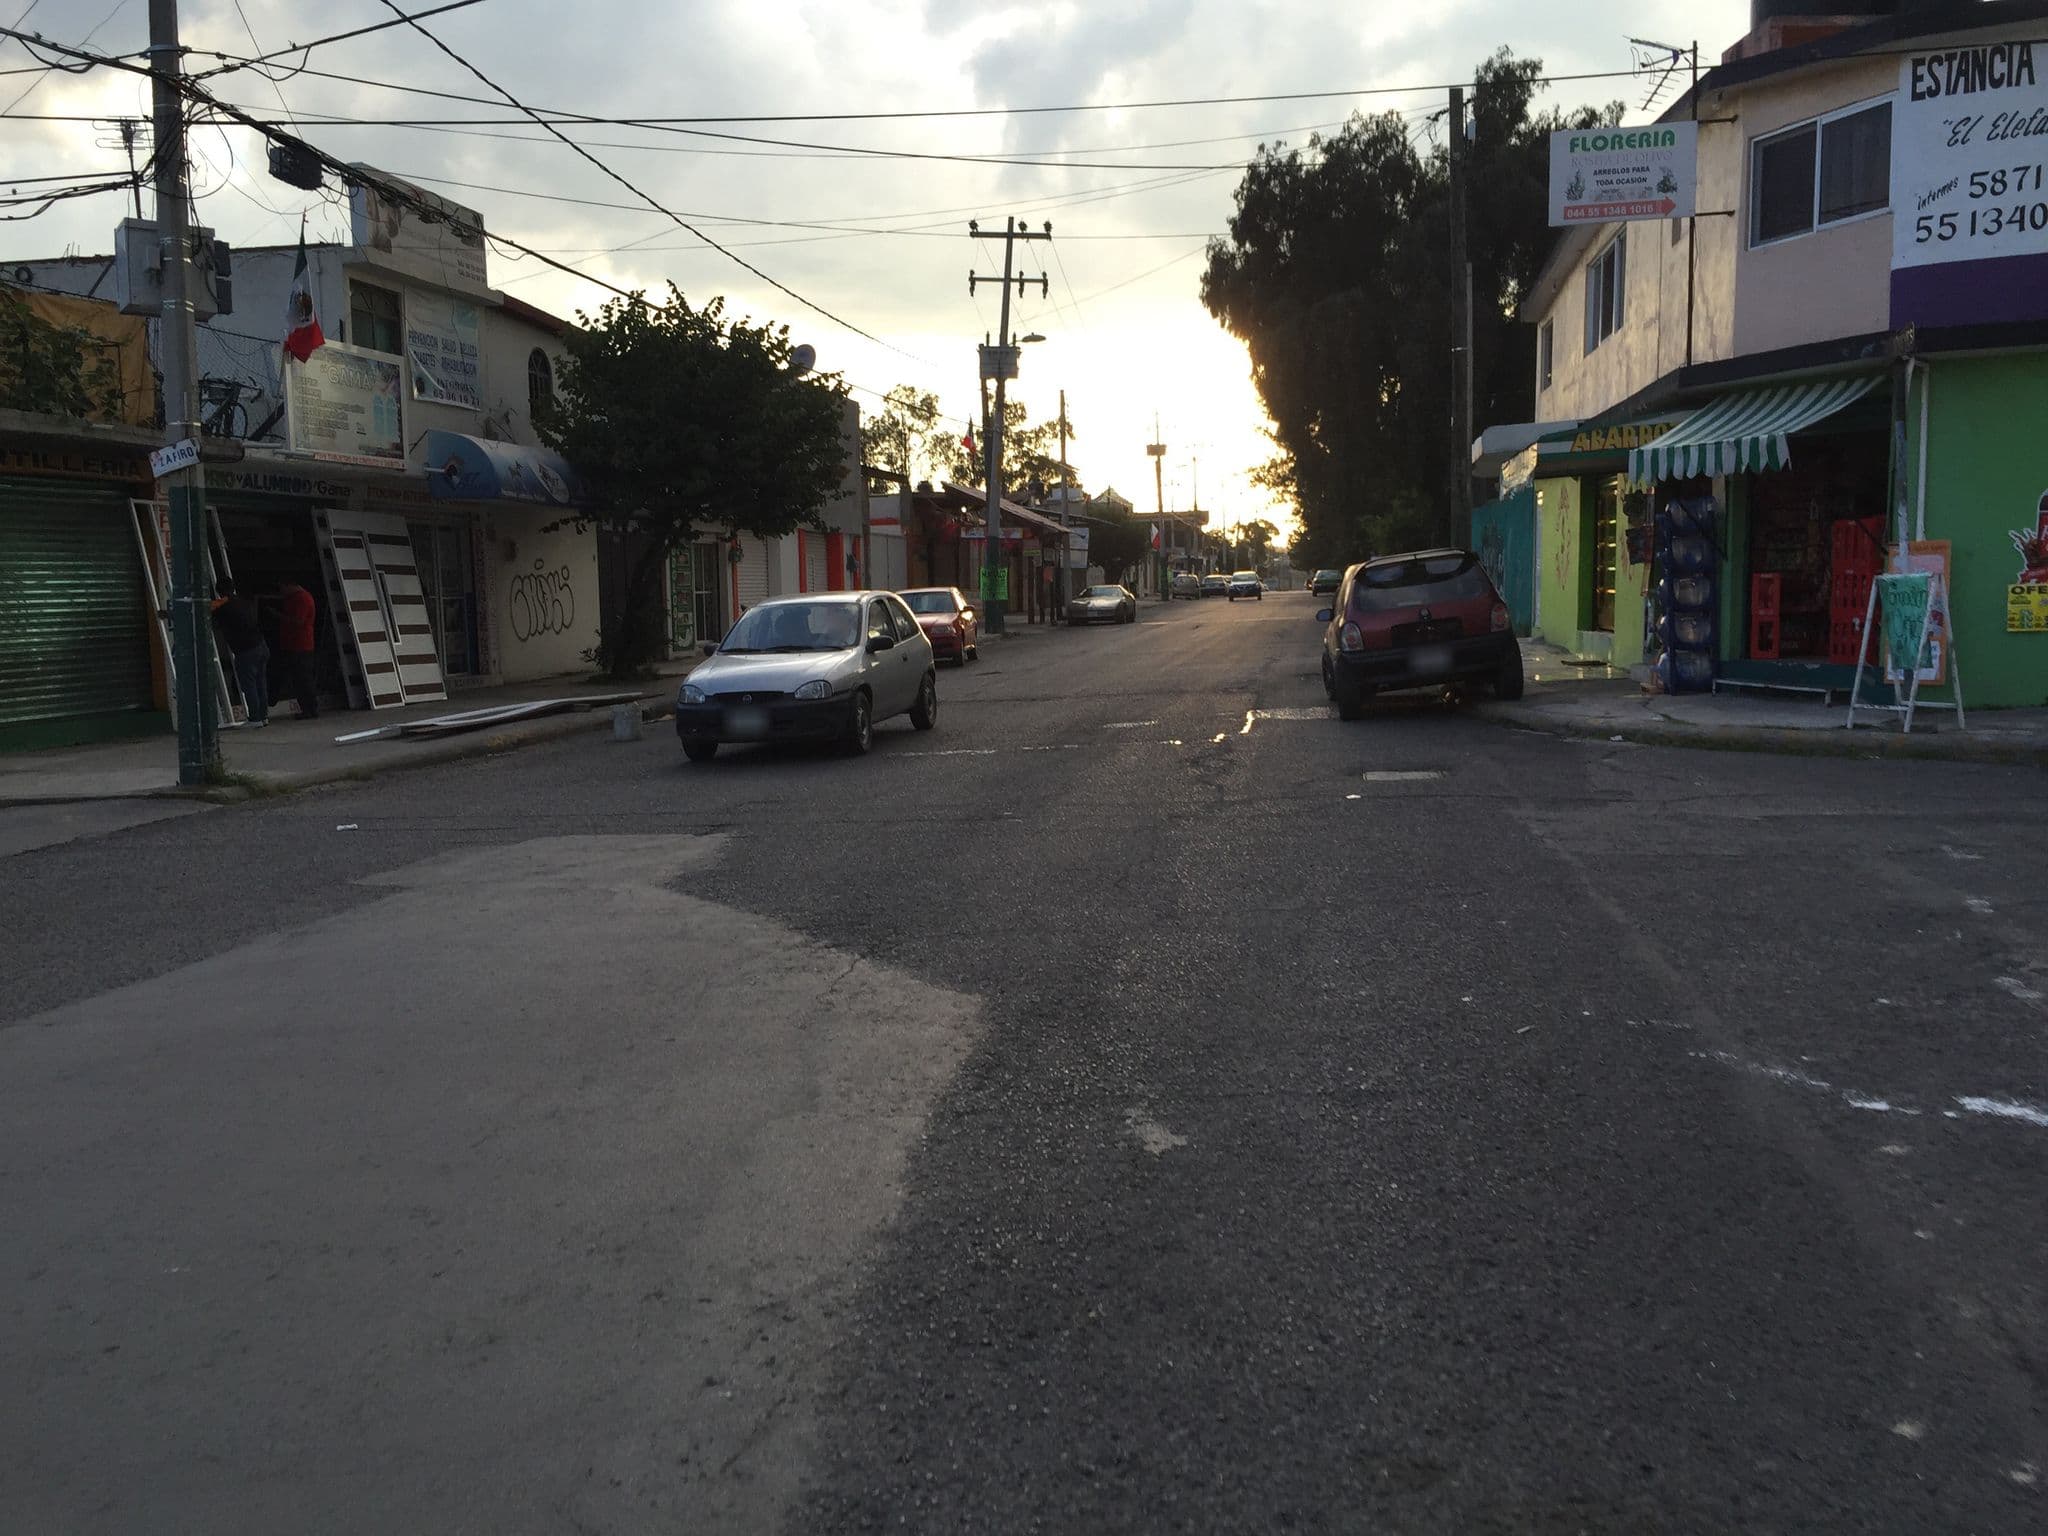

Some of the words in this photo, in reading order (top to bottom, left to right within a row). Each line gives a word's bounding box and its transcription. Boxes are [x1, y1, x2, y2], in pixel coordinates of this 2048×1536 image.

[1911, 41, 2035, 102] ESTANCIA
[1987, 107, 2048, 141] Elefa
[1570, 129, 1675, 153] FLORERIA
[1593, 167, 1630, 176] ARREGLOS
[1632, 166, 1650, 174] PARA
[1596, 178, 1614, 187] TODA
[1968, 164, 2042, 199] 5871
[1567, 208, 1585, 218] 044
[1571, 422, 1677, 454] ABARRO
